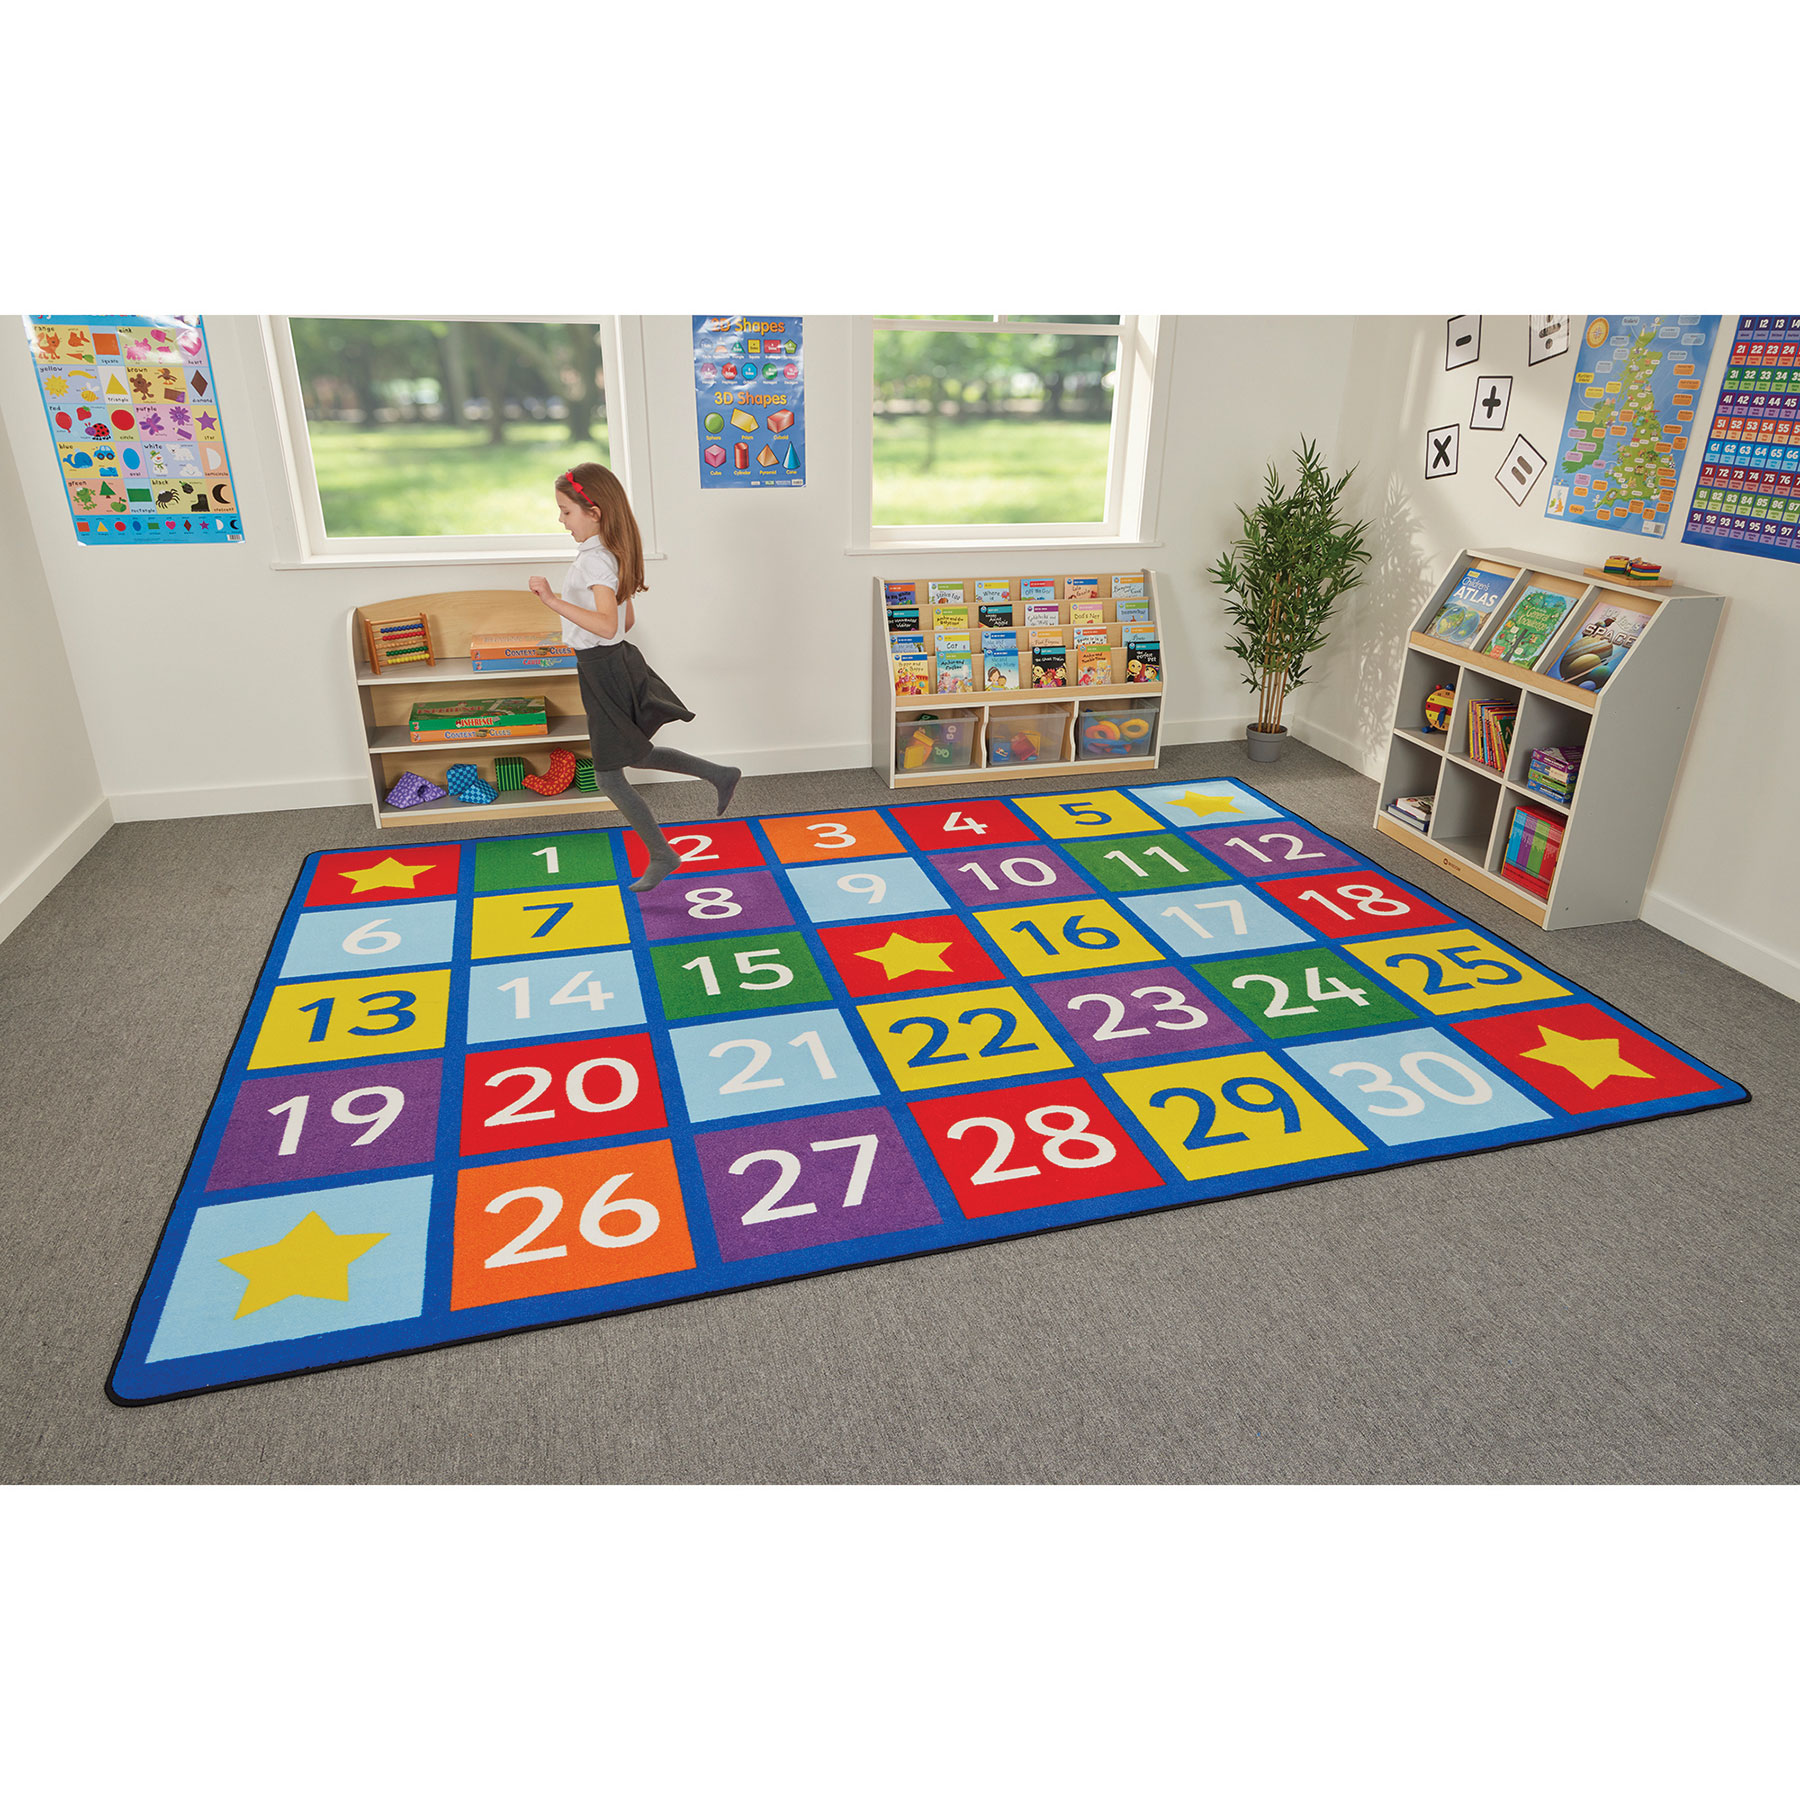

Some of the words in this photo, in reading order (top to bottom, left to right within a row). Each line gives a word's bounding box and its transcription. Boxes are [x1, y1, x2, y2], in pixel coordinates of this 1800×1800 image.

[735, 317, 785, 336] Shapes
[1744, 320, 1752, 328] 11
[1759, 319, 1769, 328] 12
[1775, 319, 1785, 328] 13
[1736, 345, 1746, 353] 21
[1751, 345, 1763, 354] 22
[1766, 345, 1779, 354] 23
[1782, 345, 1795, 354] 24
[1730, 370, 1739, 379] 31
[1744, 370, 1756, 379] 32
[1760, 371, 1771, 380] 33
[1775, 372, 1788, 380] 34
[714, 392, 733, 405] 3D
[737, 392, 787, 408] Shapes
[1723, 395, 1733, 403] 41
[1737, 396, 1750, 405] 42
[1753, 396, 1765, 406] 43
[1768, 397, 1781, 406] 44
[1784, 398, 1797, 407] 45
[1717, 419, 1726, 427] 51
[1731, 420, 1743, 429] 52
[1746, 421, 1758, 430] 53
[1761, 422, 1774, 431] 54
[1777, 424, 1790, 433] 55
[1710, 443, 1720, 451] 61
[1724, 444, 1736, 453] 62
[1739, 446, 1751, 455] 63
[1754, 447, 1767, 456] 64
[1771, 449, 1783, 458] 65
[1786, 450, 1799, 459] 66
[1704, 467, 1713, 476] 71
[1719, 469, 1729, 477] 72
[1733, 470, 1744, 479] 73
[1749, 472, 1759, 481] 74
[1764, 473, 1775, 483] 75
[1780, 475, 1791, 484] 76
[1699, 490, 1708, 499] 81
[1711, 492, 1723, 500] 82
[1726, 494, 1738, 503] 83
[1741, 496, 1753, 504] 84
[1756, 498, 1769, 507] 85
[1771, 500, 1784, 509] 86
[1788, 502, 1800, 511] 87
[1693, 513, 1702, 522] 91
[1706, 515, 1717, 524] 92
[1720, 517, 1731, 527] 93
[1734, 519, 1746, 529] 94
[1749, 522, 1761, 531] 95
[1764, 524, 1776, 534] 96
[1781, 527, 1793, 536] 97
[1462, 577, 1490, 591] Children's
[1453, 586, 1498, 607] ATLAS
[1582, 623, 1638, 649] SPACE
[505, 648, 536, 657] CONTEXT
[549, 647, 572, 655] CLUES
[461, 717, 494, 727] INFERENCE
[445, 731, 476, 739] CONTEXT
[537, 847, 559, 873] 1
[679, 835, 714, 862] 2
[807, 823, 856, 848] 3
[943, 812, 987, 834] 4
[1060, 802, 1111, 825] 5
[343, 919, 401, 954] 6
[524, 903, 573, 937] 7
[685, 888, 742, 919] 8
[837, 874, 886, 904] 9
[958, 858, 1056, 890] 10
[1104, 847, 1188, 876] 11
[1224, 834, 1326, 862] 12
[300, 990, 416, 1042] 13
[498, 971, 614, 1018] 14
[682, 949, 793, 995] 15
[1011, 914, 1120, 955] 16
[1162, 900, 1247, 938] 17
[1298, 885, 1410, 920] 18
[268, 1086, 404, 1155] 19
[485, 1058, 638, 1126] 20
[709, 1031, 836, 1094] 21
[888, 1007, 1038, 1067] 22
[1068, 986, 1208, 1041] 23
[1233, 967, 1369, 1017] 24
[1385, 944, 1522, 996] 25
[485, 1173, 660, 1268] 26
[728, 1134, 879, 1225] 27
[947, 1105, 1116, 1185] 28
[1149, 1077, 1301, 1151] 29
[1328, 1052, 1492, 1118] 30
